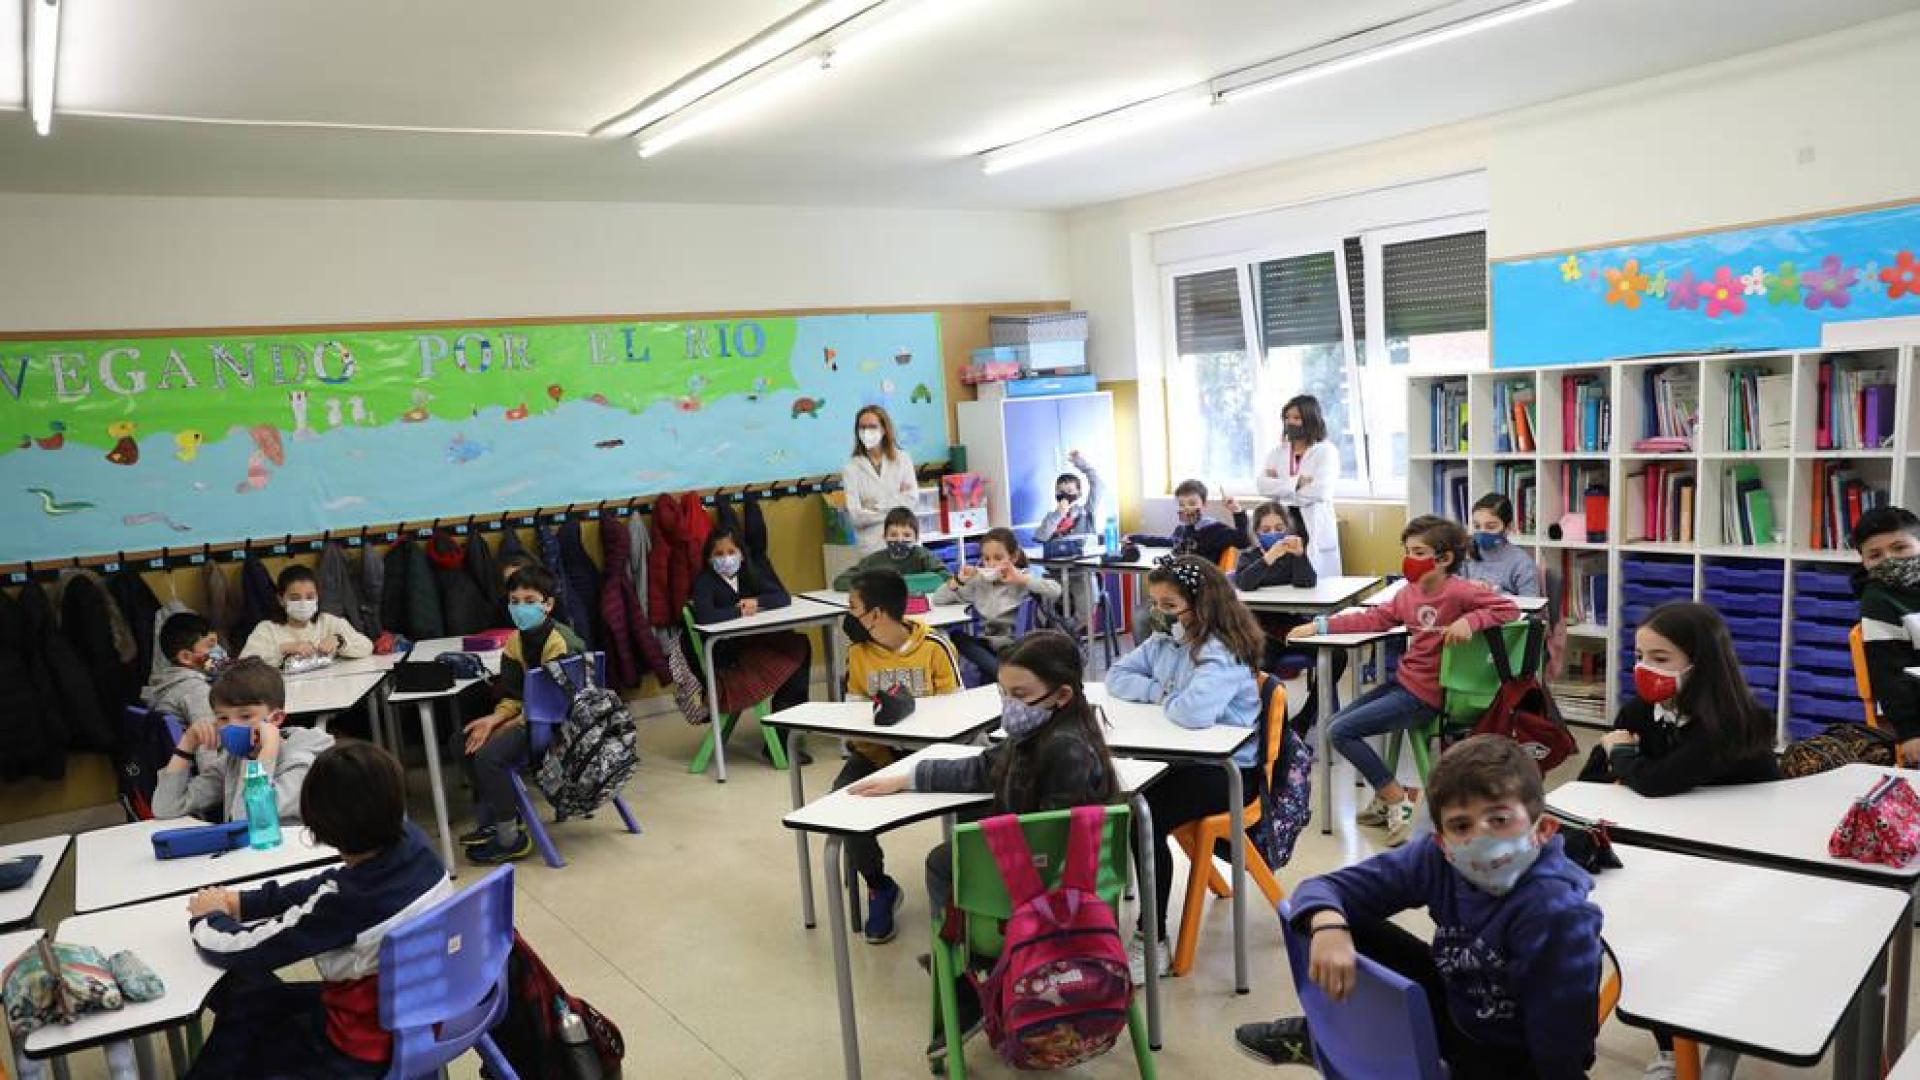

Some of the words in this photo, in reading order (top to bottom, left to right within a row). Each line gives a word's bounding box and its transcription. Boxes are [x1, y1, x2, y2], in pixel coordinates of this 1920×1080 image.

[0, 340, 355, 401] VEGANDO
[417, 333, 534, 378] POR
[589, 326, 650, 367] EL
[685, 320, 766, 359] RIO
